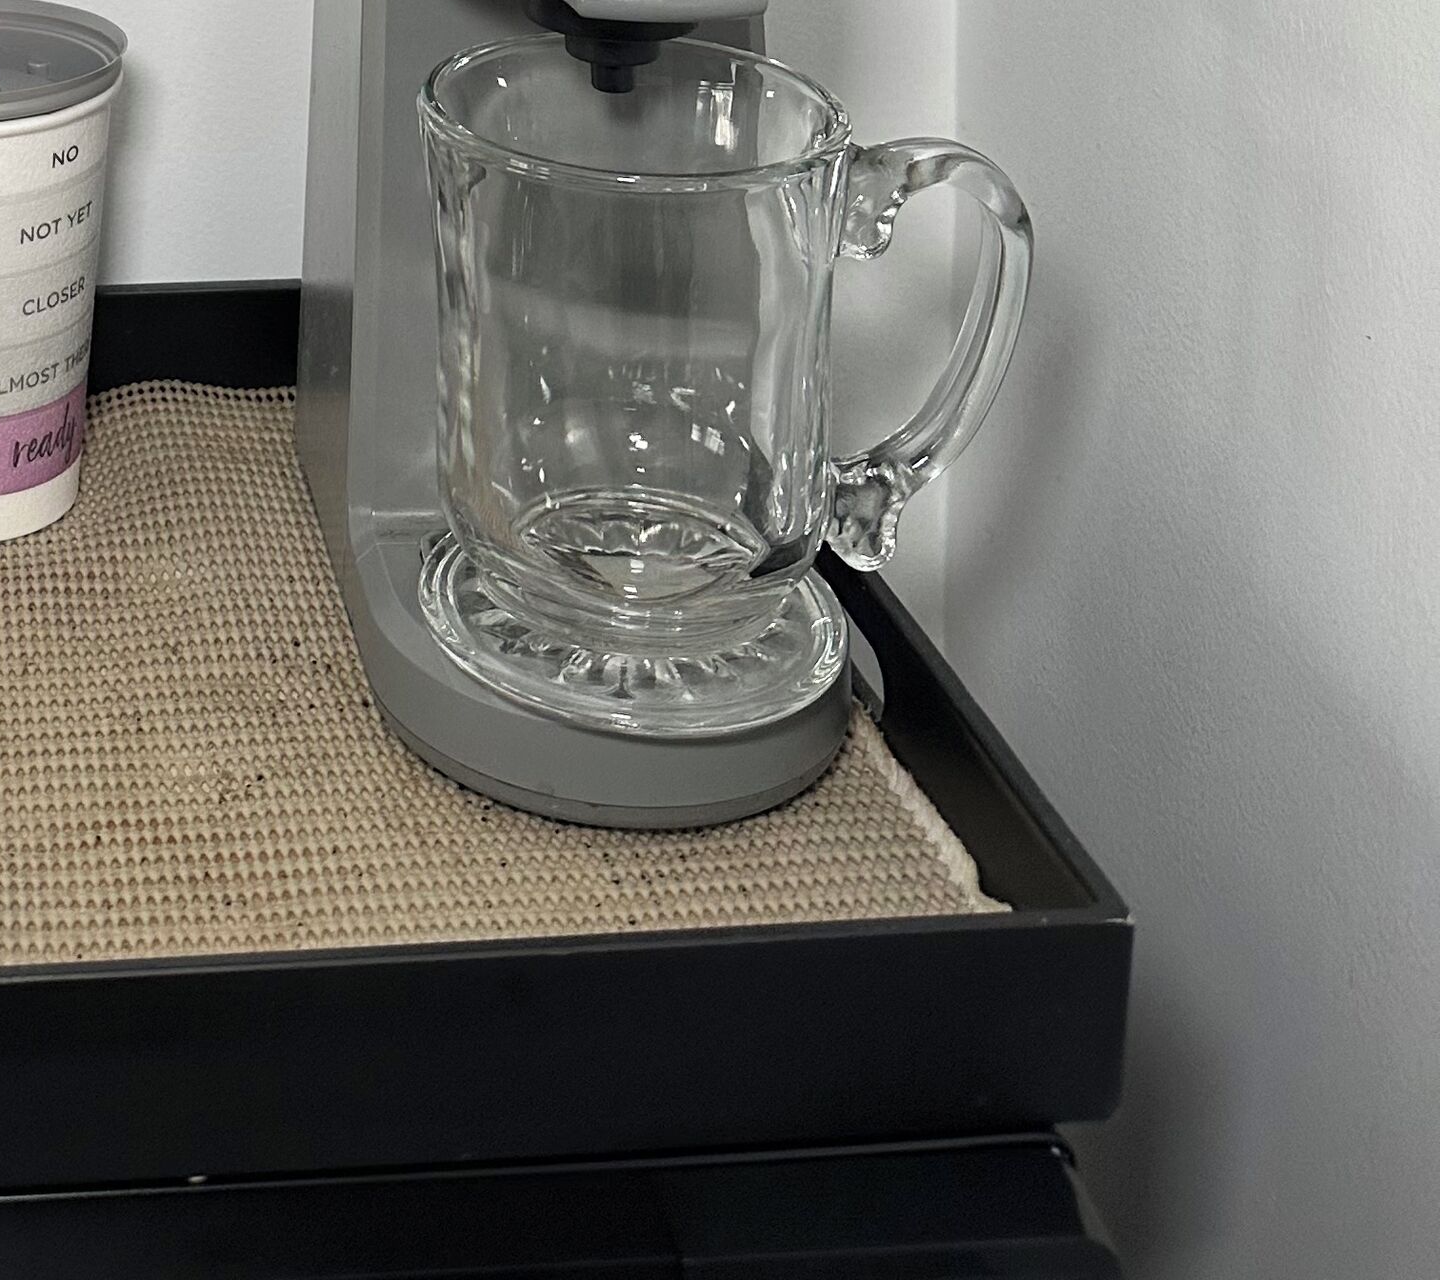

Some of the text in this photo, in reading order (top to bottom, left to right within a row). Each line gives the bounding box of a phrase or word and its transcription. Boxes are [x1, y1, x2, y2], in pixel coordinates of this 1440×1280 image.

[52, 145, 79, 168] NO
[20, 201, 93, 245] NOT YET
[22, 276, 85, 316] CLOSER
[12, 401, 76, 468] ready
